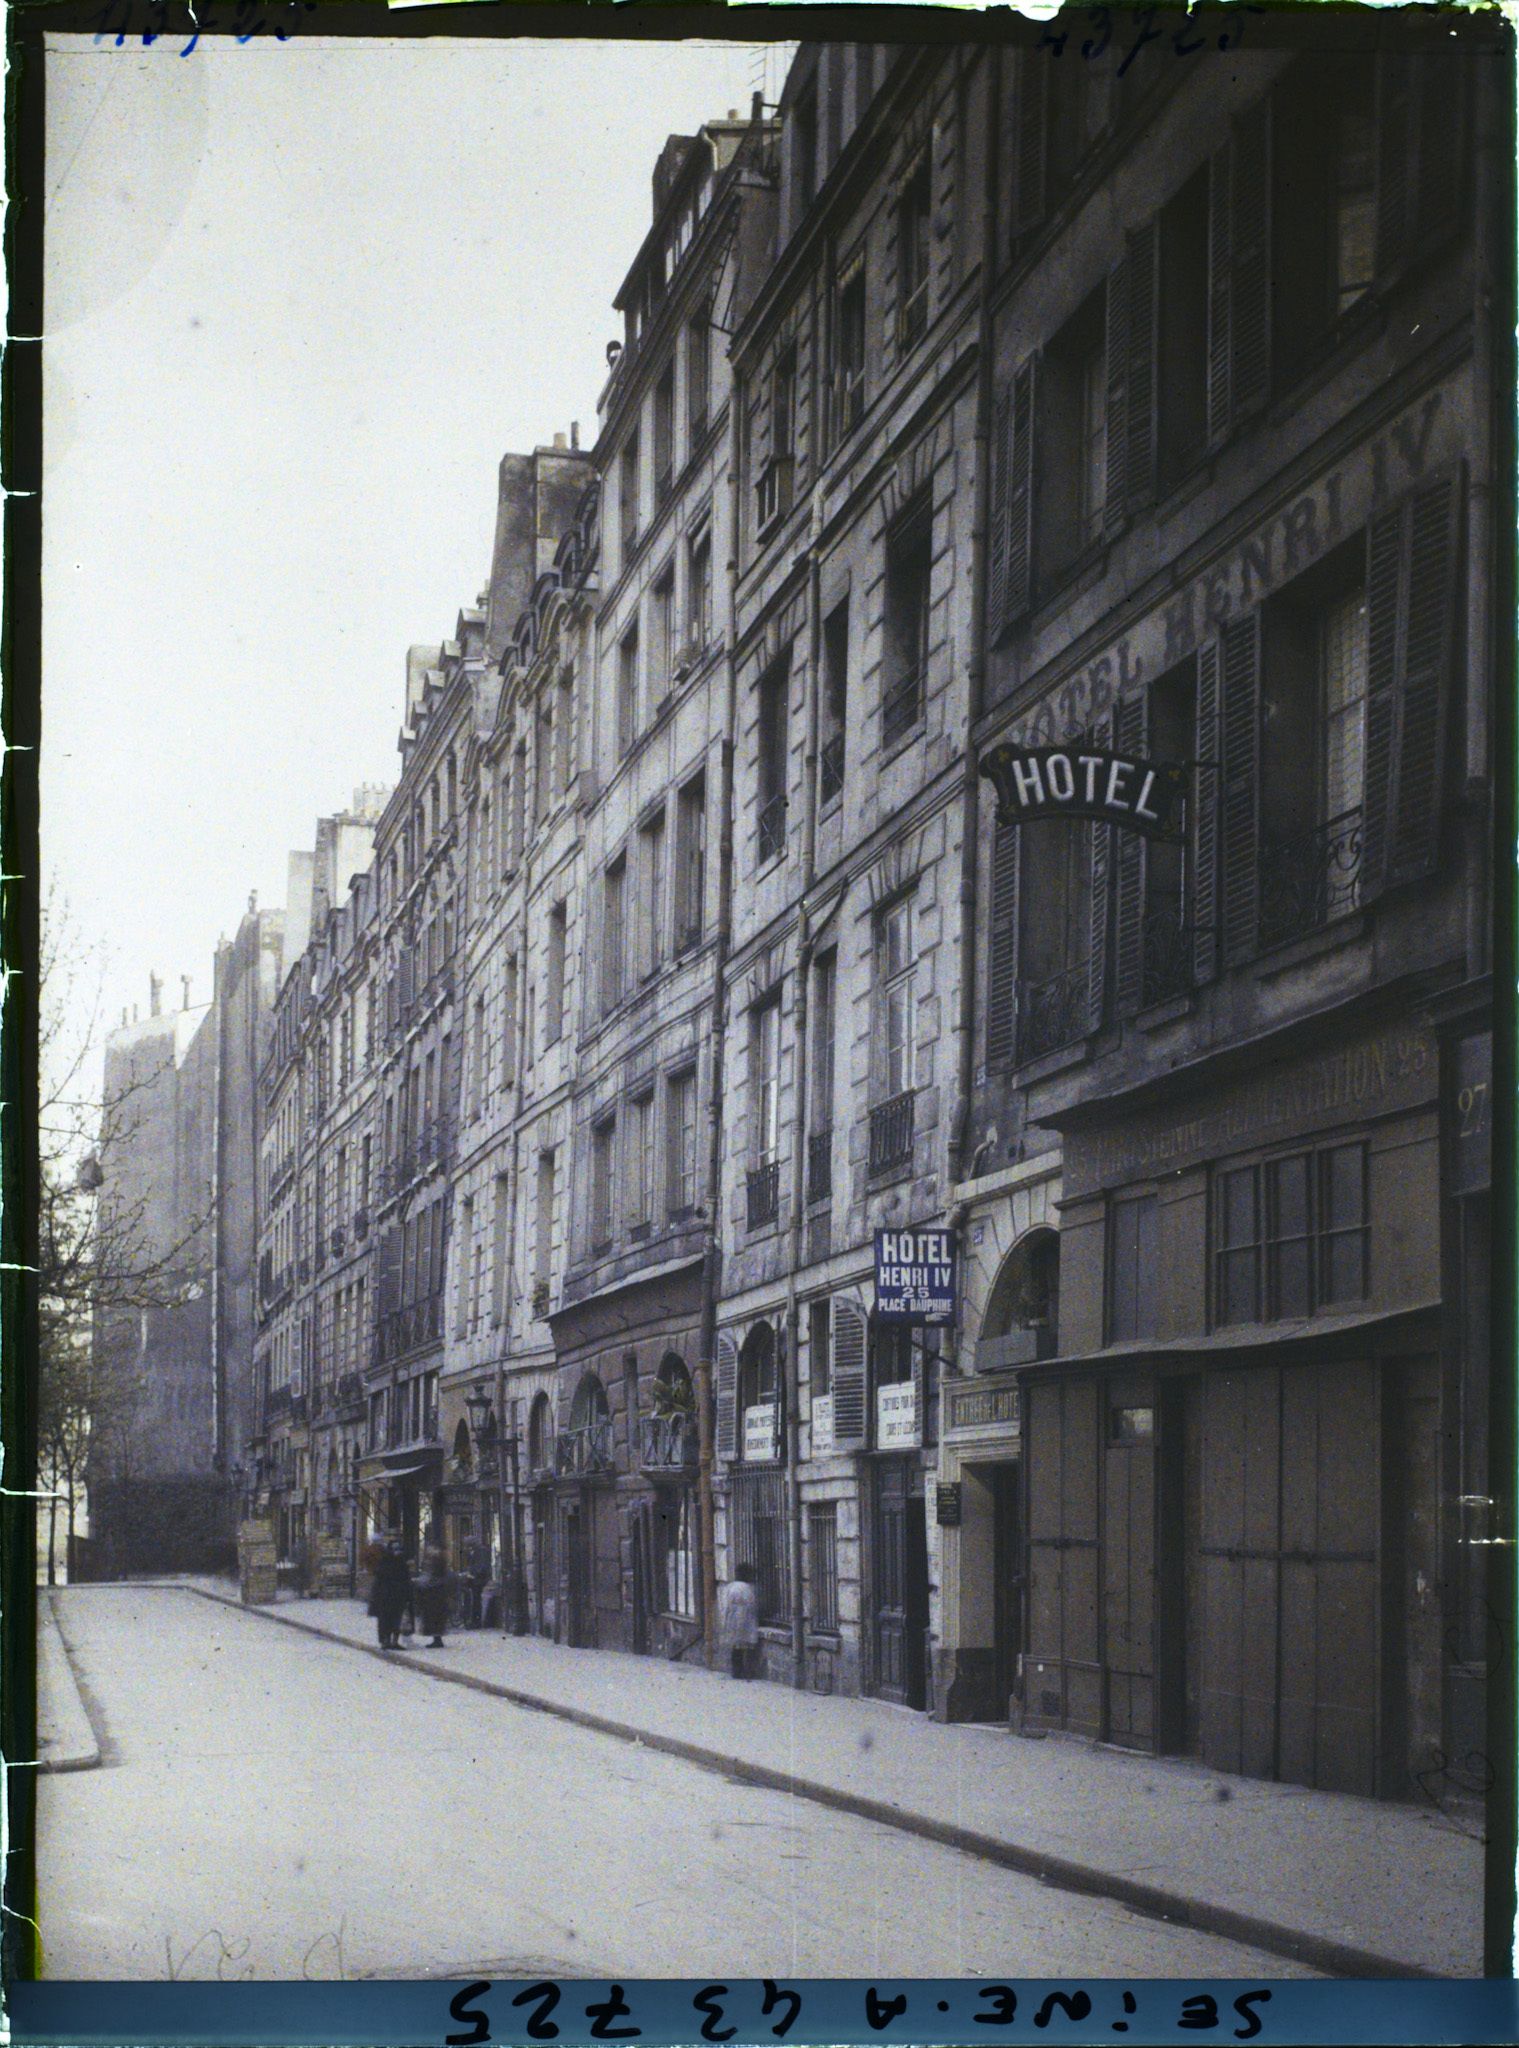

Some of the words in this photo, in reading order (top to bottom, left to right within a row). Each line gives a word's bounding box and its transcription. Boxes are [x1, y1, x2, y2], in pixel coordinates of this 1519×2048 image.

[1164, 472, 1343, 661] HENRI
[1369, 392, 1443, 514] IV
[1012, 753, 1158, 820] HOTEL
[882, 1231, 952, 1264] HÔTEL
[880, 1266, 928, 1287] HENRI
[934, 1267, 952, 1288] IV
[878, 1297, 907, 1312] PLACE
[910, 1298, 953, 1313] DAUPHINE
[902, 1286, 930, 1299] 25
